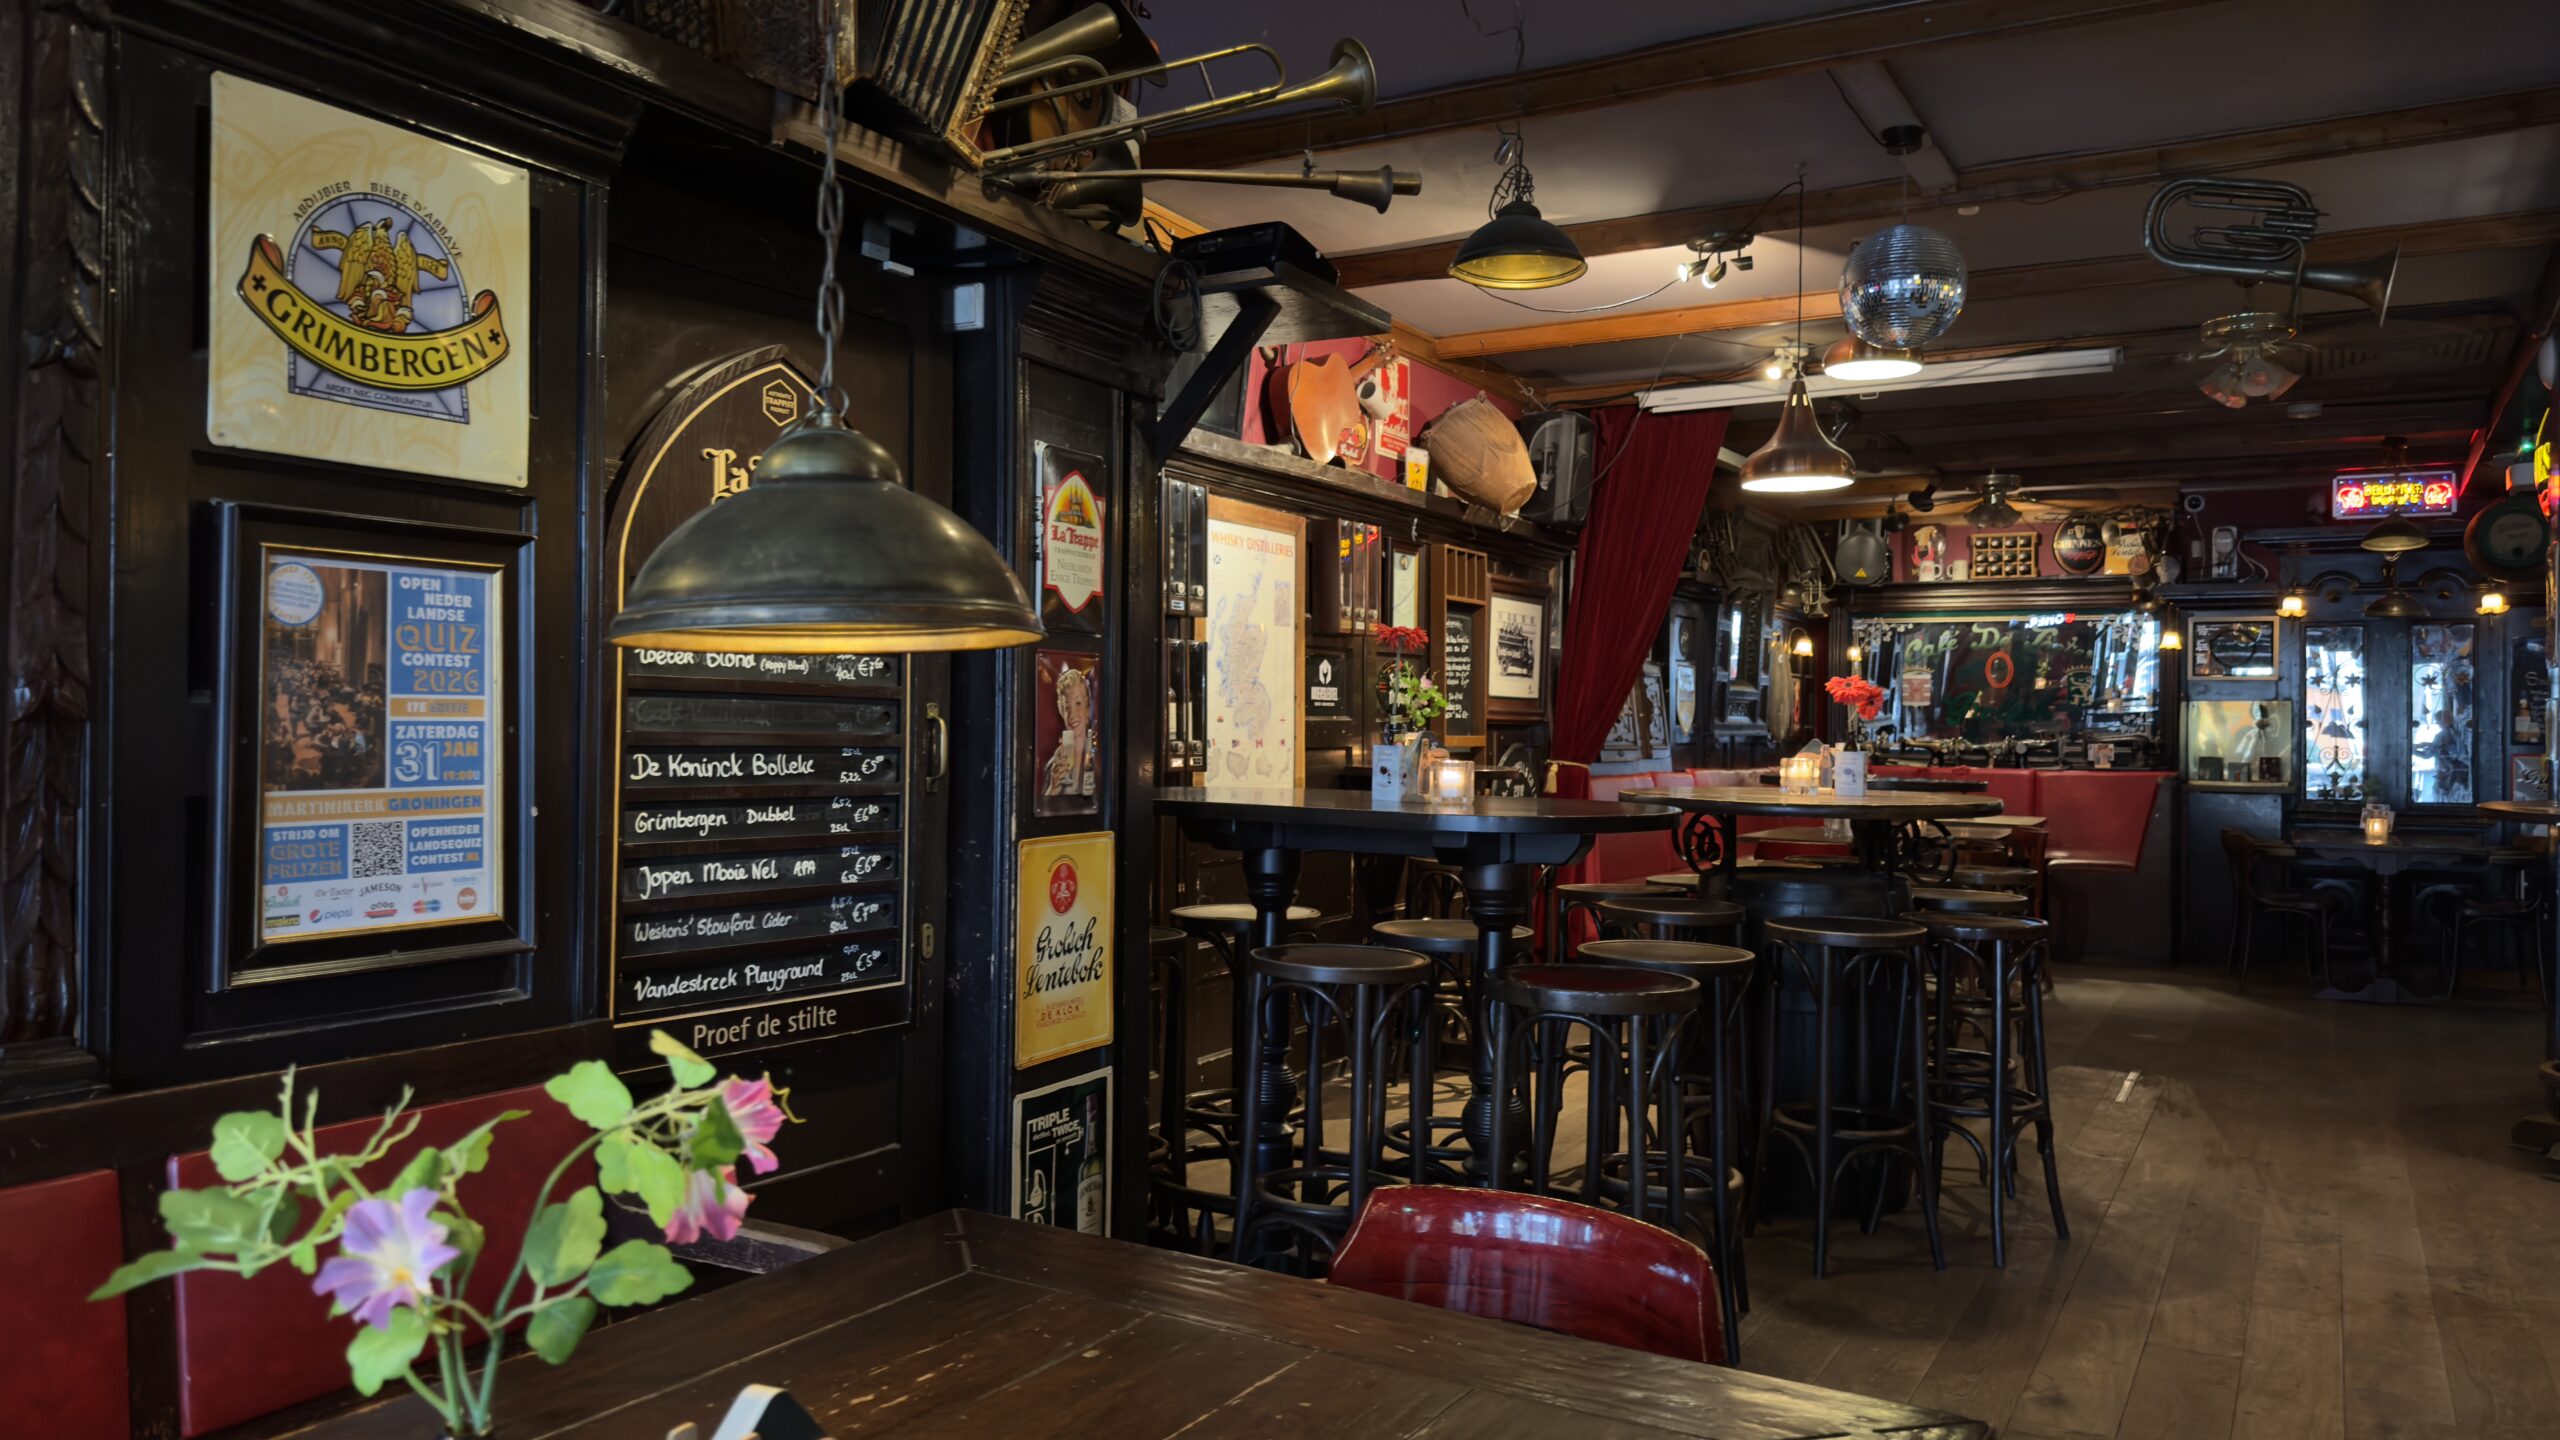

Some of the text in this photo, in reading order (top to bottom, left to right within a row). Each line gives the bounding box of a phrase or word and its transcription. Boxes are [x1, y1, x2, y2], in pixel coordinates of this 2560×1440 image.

[293, 180, 352, 223] ABDIJBIER
[413, 200, 463, 258] D'ABBAYE
[318, 234, 345, 246] ANNO
[266, 289, 490, 378] GRIMBERGEN
[702, 447, 750, 505] La
[1051, 524, 1100, 552] La Trappe
[1211, 531, 1294, 558] WHISKY DISTILLERIES
[400, 576, 441, 591] OPEN
[424, 593, 473, 608] NEDER
[407, 606, 465, 622] LANDSE
[396, 623, 480, 654] QUIZ
[401, 652, 472, 667] CONTEST
[413, 669, 480, 693] 2026
[395, 725, 480, 739] ZATERDAG
[394, 740, 480, 782] 31 JAN
[630, 752, 816, 780] De Koninck Bolleke
[267, 794, 482, 818] MARTINIKERK GRONINGEN
[411, 824, 480, 838] OPENNEDER
[634, 805, 796, 837] Grimbergen Dubbel
[272, 827, 340, 841] STRIJD OM
[409, 837, 482, 852] LANDSEQUIZ
[270, 841, 341, 861] GROTE
[267, 859, 343, 880] PRIJZEN
[639, 865, 694, 900] Jopen
[702, 862, 749, 883] Mooie
[751, 858, 779, 881] Nel
[358, 881, 403, 898] JAMESON
[323, 907, 353, 920] pepsi
[696, 912, 756, 937] Stowford
[761, 912, 793, 929] Cider
[1036, 916, 1097, 963] Grolsch
[634, 959, 824, 1001] Vandestreek Playground
[1023, 946, 1104, 999] Lentebok
[693, 1004, 838, 1048] Proef de stilte
[1032, 1107, 1070, 1133] TRIPLE
[1051, 1119, 1080, 1138] TWICE
